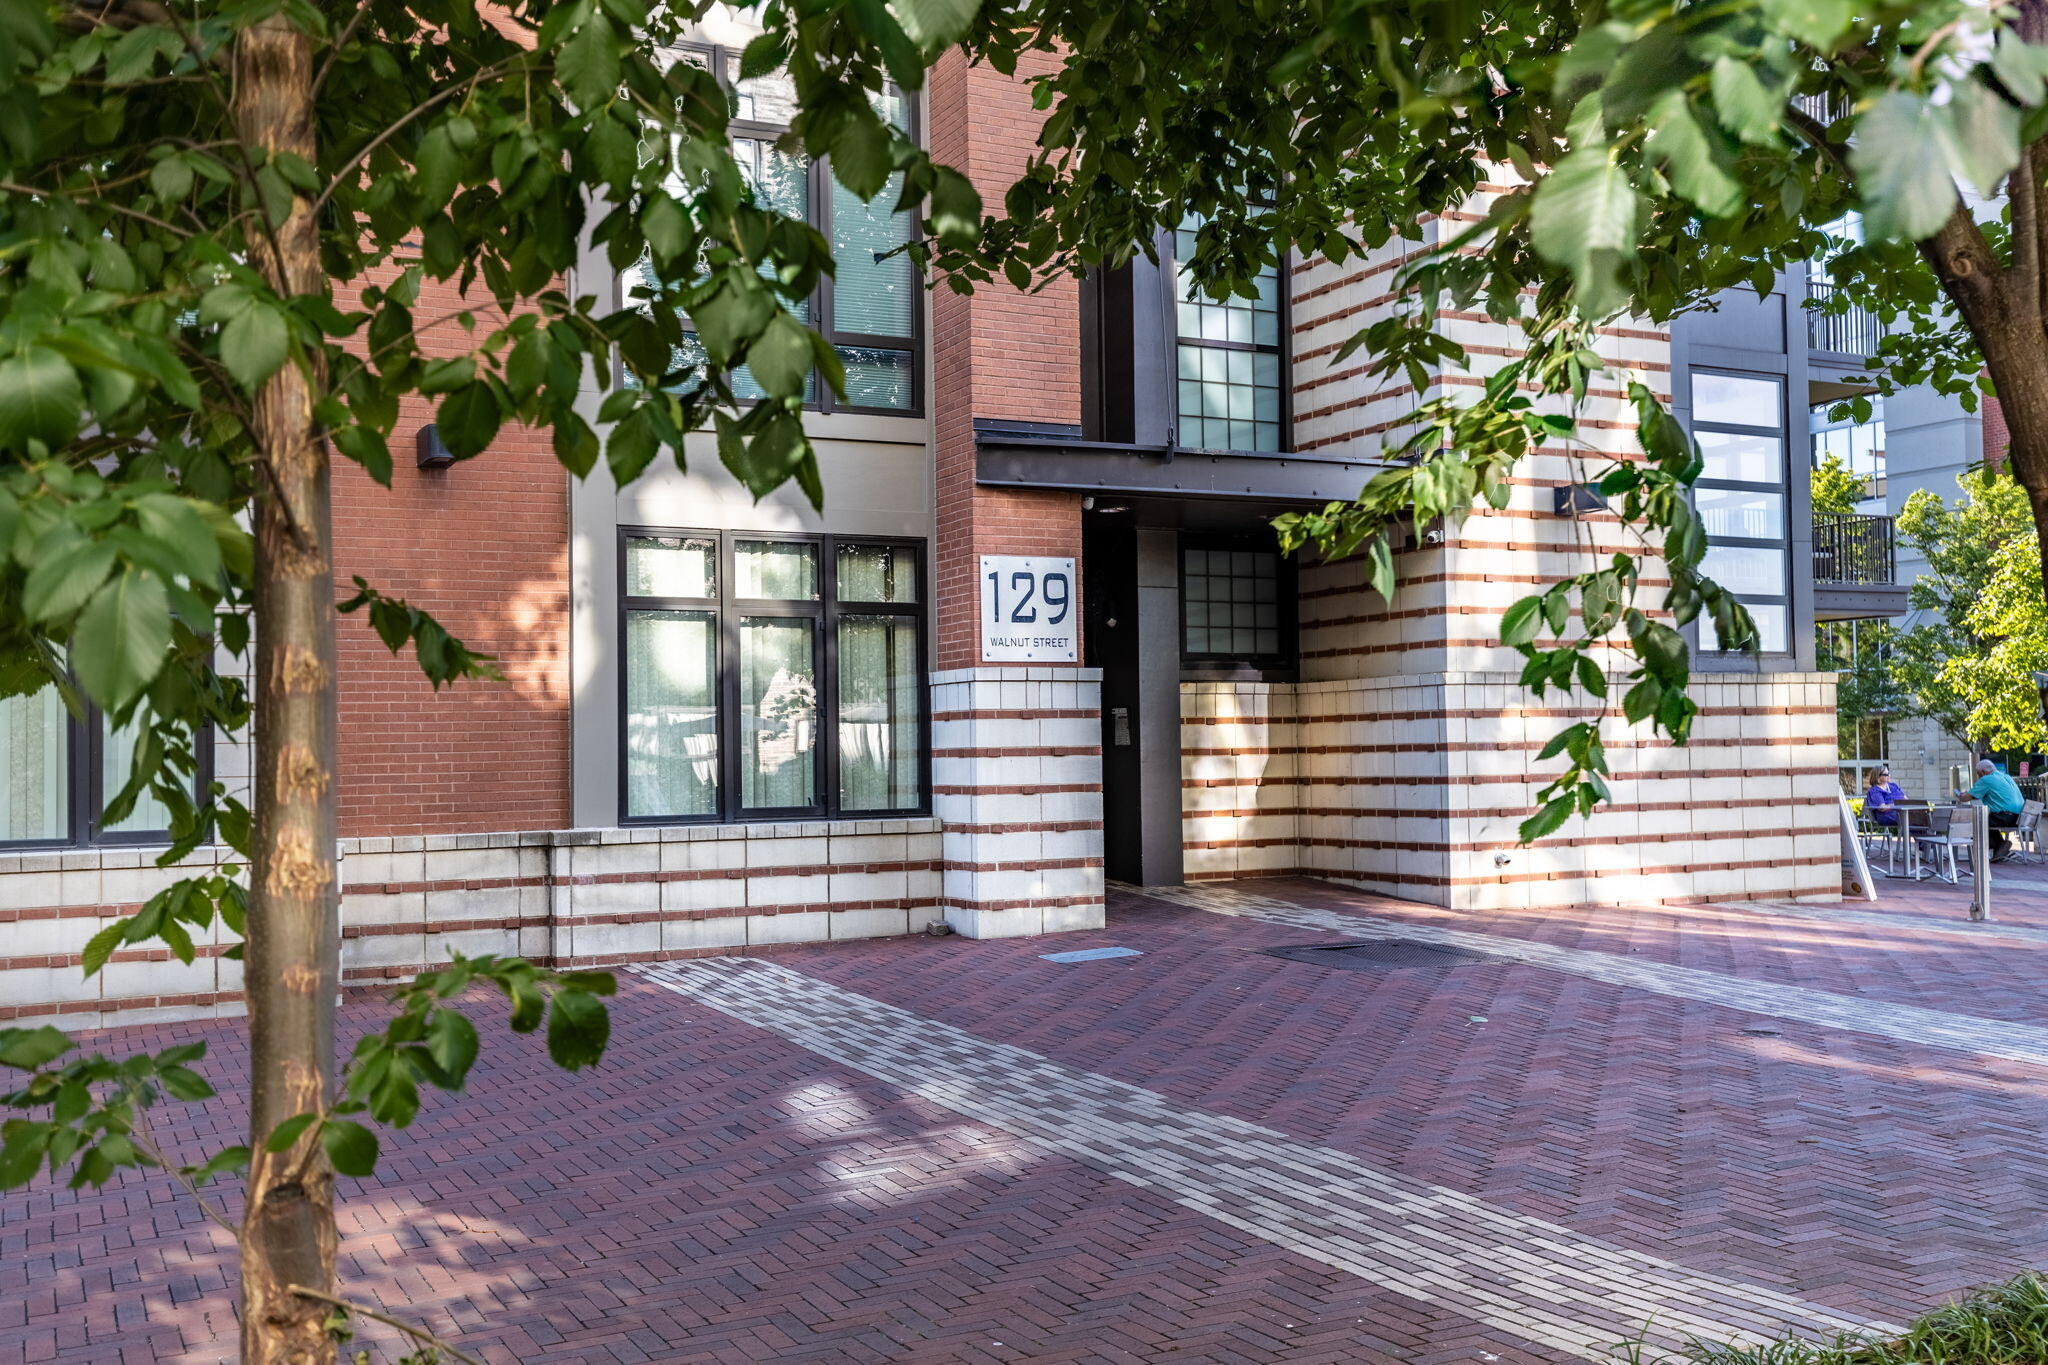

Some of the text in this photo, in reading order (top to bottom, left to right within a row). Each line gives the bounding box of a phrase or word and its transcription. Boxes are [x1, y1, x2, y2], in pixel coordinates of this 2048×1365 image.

[988, 571, 1069, 625] 129
[990, 637, 1069, 648] WALNUT STREET
